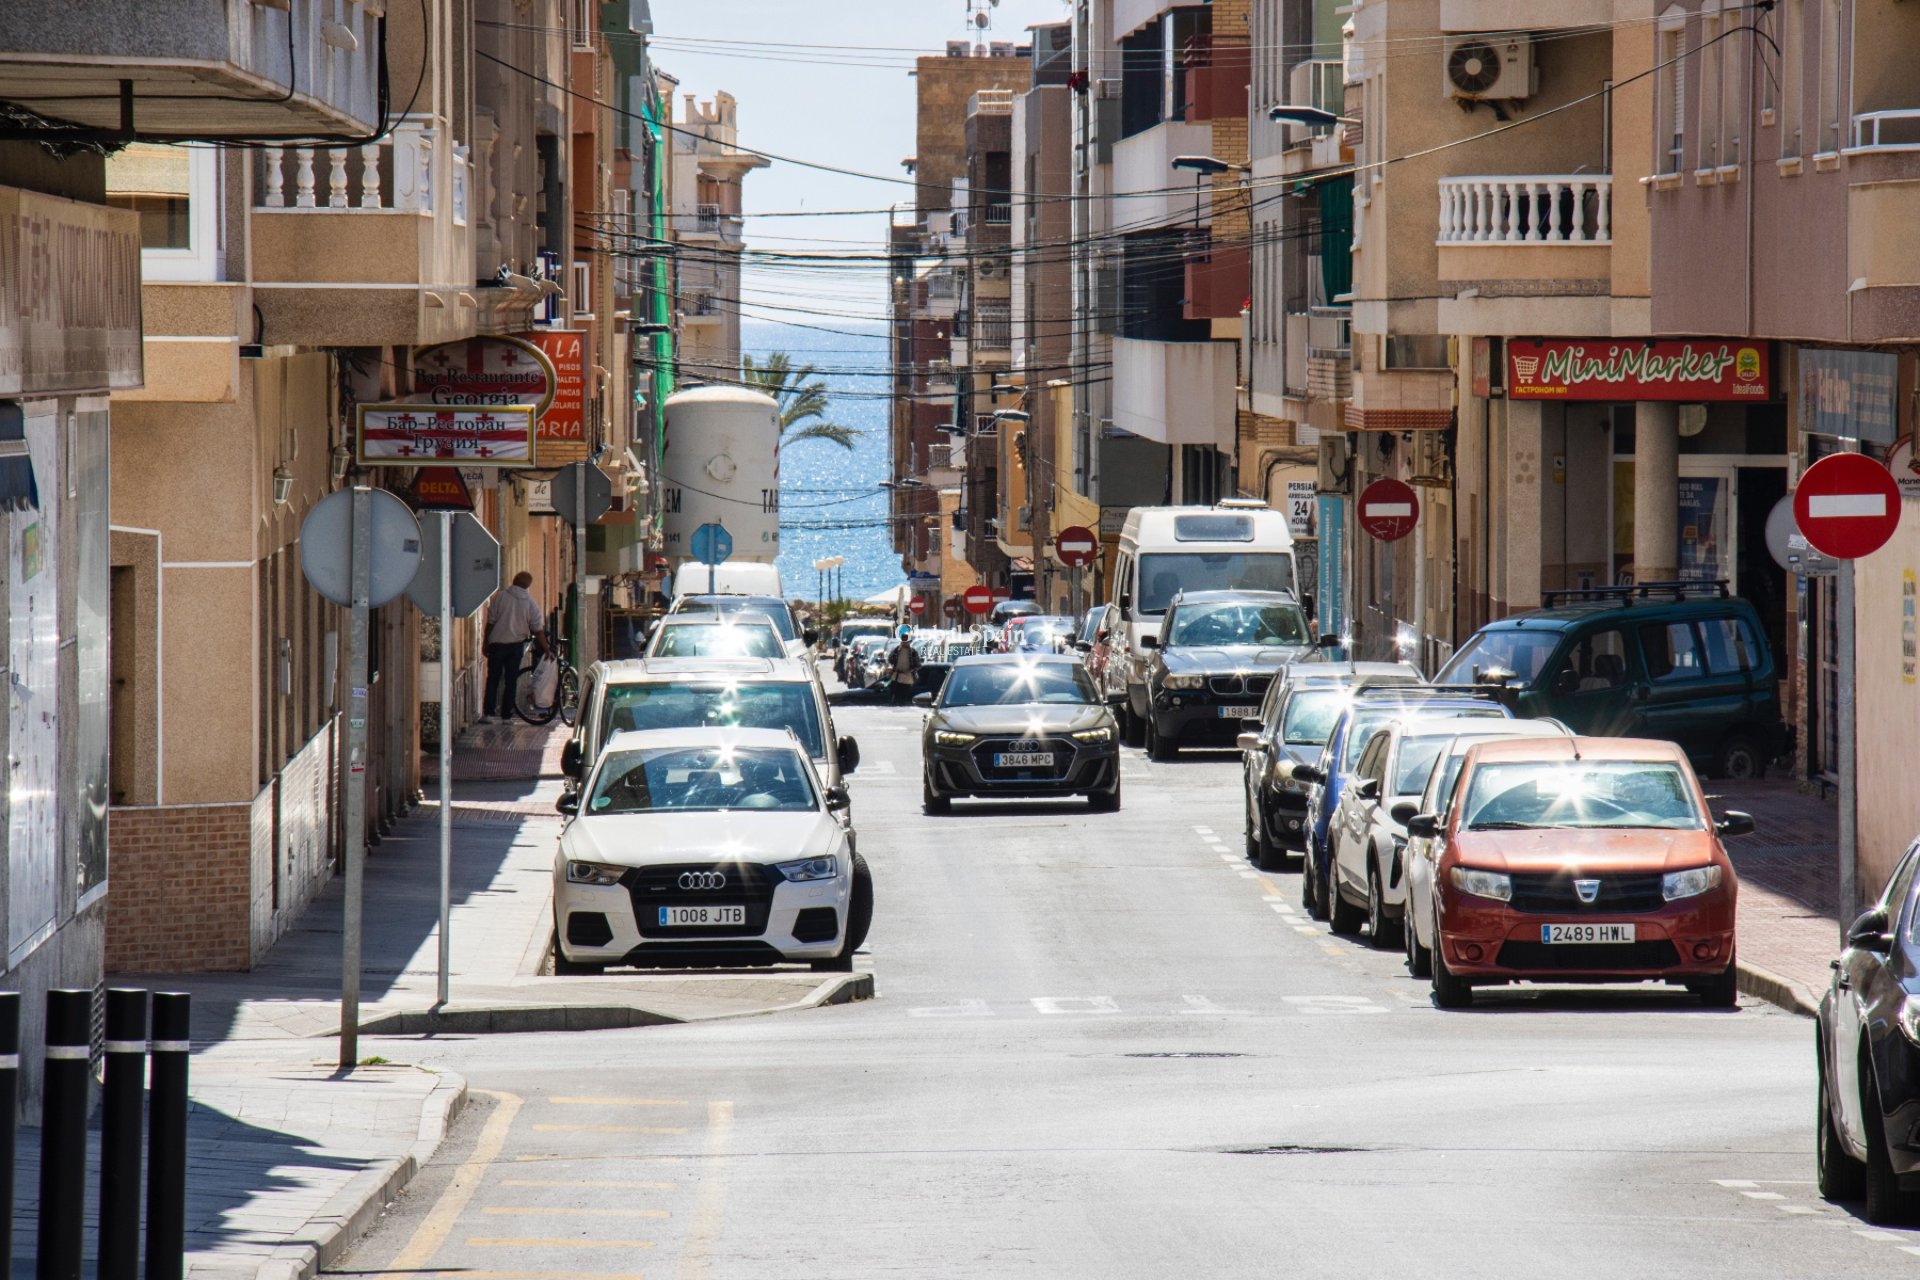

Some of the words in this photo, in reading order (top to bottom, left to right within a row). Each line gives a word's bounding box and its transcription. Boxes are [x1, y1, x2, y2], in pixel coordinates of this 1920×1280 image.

[558, 363, 581, 371] PISOS
[1541, 345, 1734, 385] MiniMarket
[415, 367, 444, 383] Bar
[447, 367, 538, 383] Restaurante
[431, 384, 520, 405] Georgia
[556, 389, 581, 397] FINCAS
[1515, 386, 1555, 394] ГАСТРОНОМ
[386, 416, 506, 434] Бар-Ресторан
[413, 433, 480, 453] Грузия
[419, 481, 460, 494] DELTA
[664, 488, 682, 513] EM
[1294, 500, 1308, 516] 24
[1002, 755, 1028, 765] 3846
[1030, 754, 1051, 765] MPC
[672, 909, 708, 923] 1008
[713, 908, 742, 922] JTB
[1553, 926, 1594, 942] 2489
[1599, 926, 1631, 941] HWL
